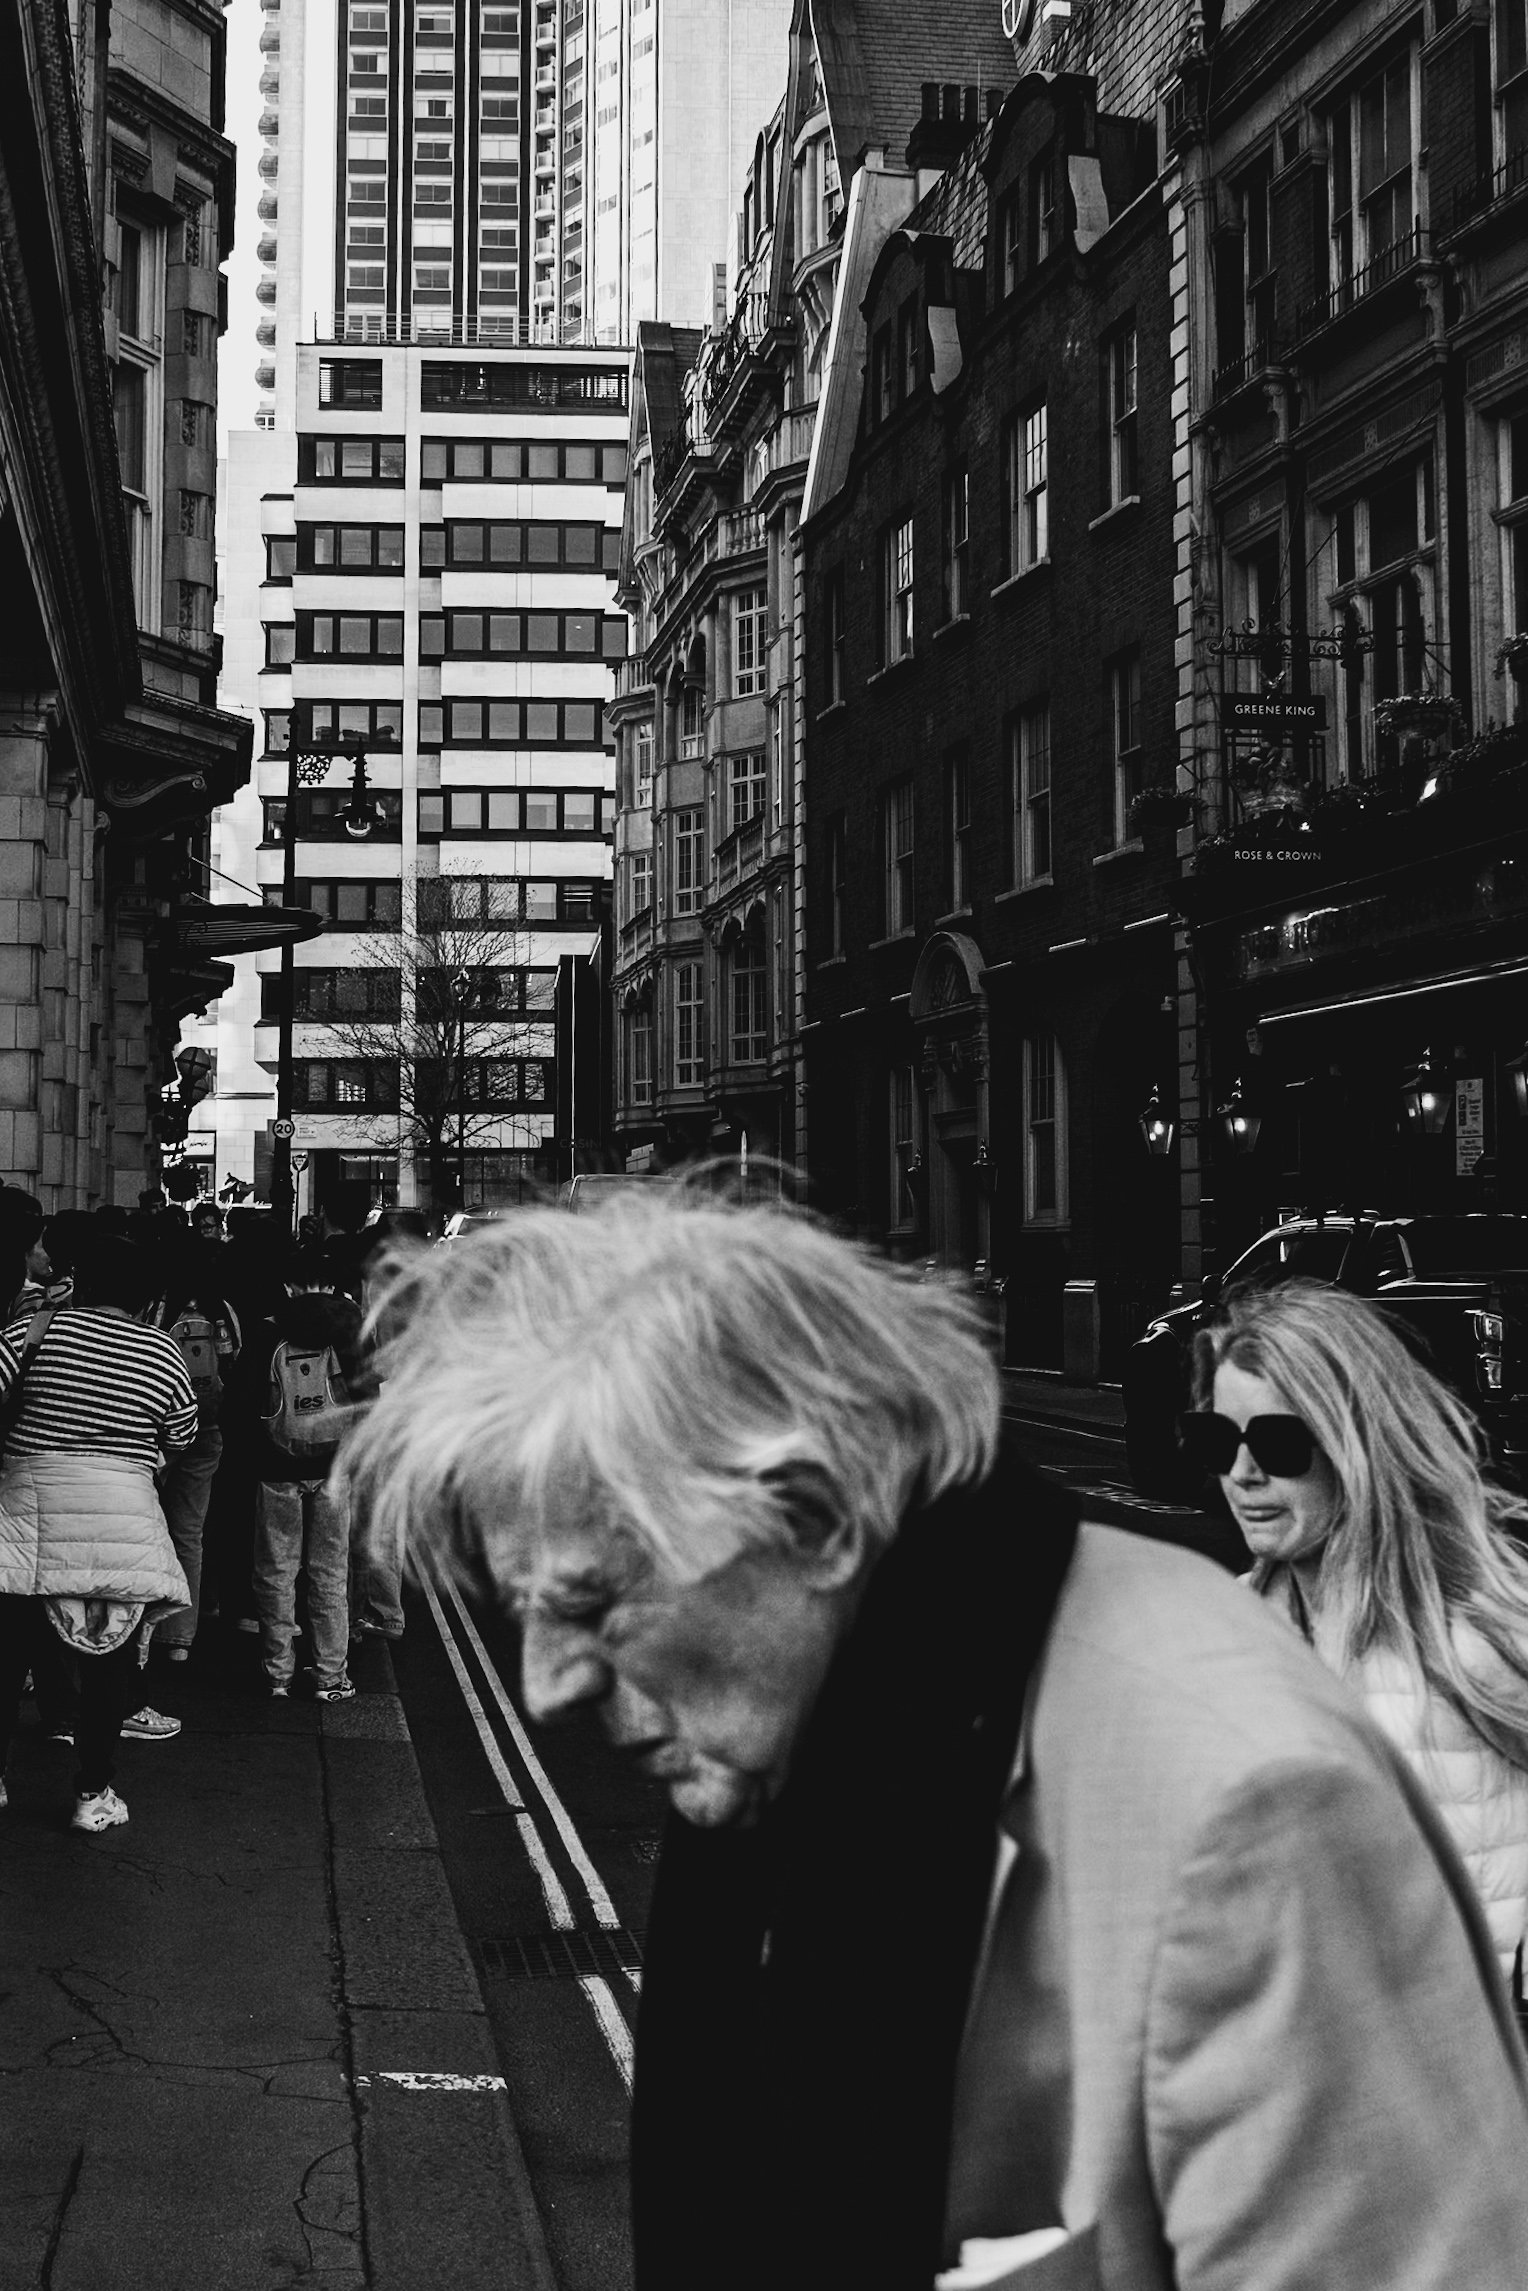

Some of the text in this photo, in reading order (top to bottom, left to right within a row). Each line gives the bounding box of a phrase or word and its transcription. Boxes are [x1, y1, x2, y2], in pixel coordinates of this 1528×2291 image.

[1234, 704, 1315, 716] GREENE KING
[1234, 850, 1321, 860] ROSE & CROWN
[276, 1123, 292, 1134] 20
[294, 1394, 324, 1409] ies
